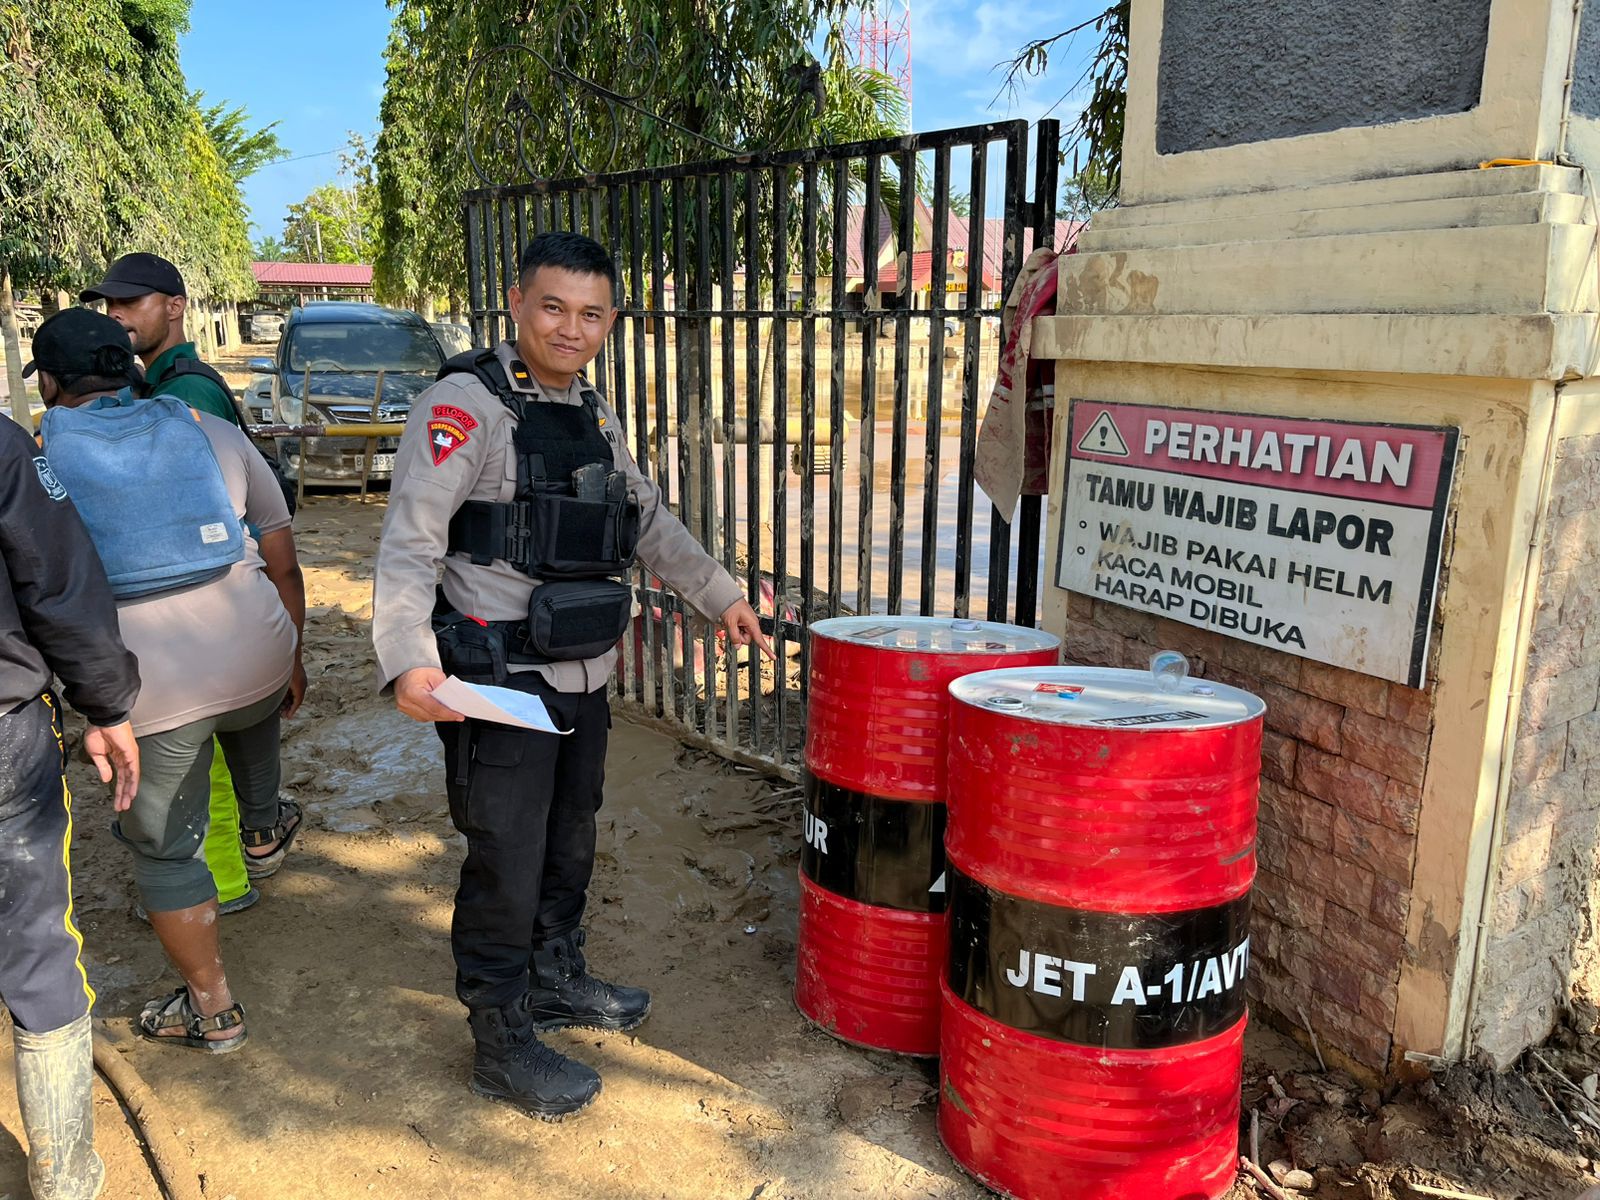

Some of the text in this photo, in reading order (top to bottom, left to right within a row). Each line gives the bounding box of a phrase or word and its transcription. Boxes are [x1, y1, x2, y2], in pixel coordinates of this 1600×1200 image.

[435, 406, 474, 428] PELOPOR
[1144, 419, 1414, 488] PERHATIAN
[1086, 473, 1395, 557] TAMU WAJIB LAPOR
[1097, 552, 1264, 608] KACA MOBIL
[1099, 520, 1393, 605] WAJIB PAKAI HELM
[1095, 574, 1307, 649] HARAP DIBUKA
[803, 806, 829, 855] UR
[1007, 950, 1097, 1002] JET
